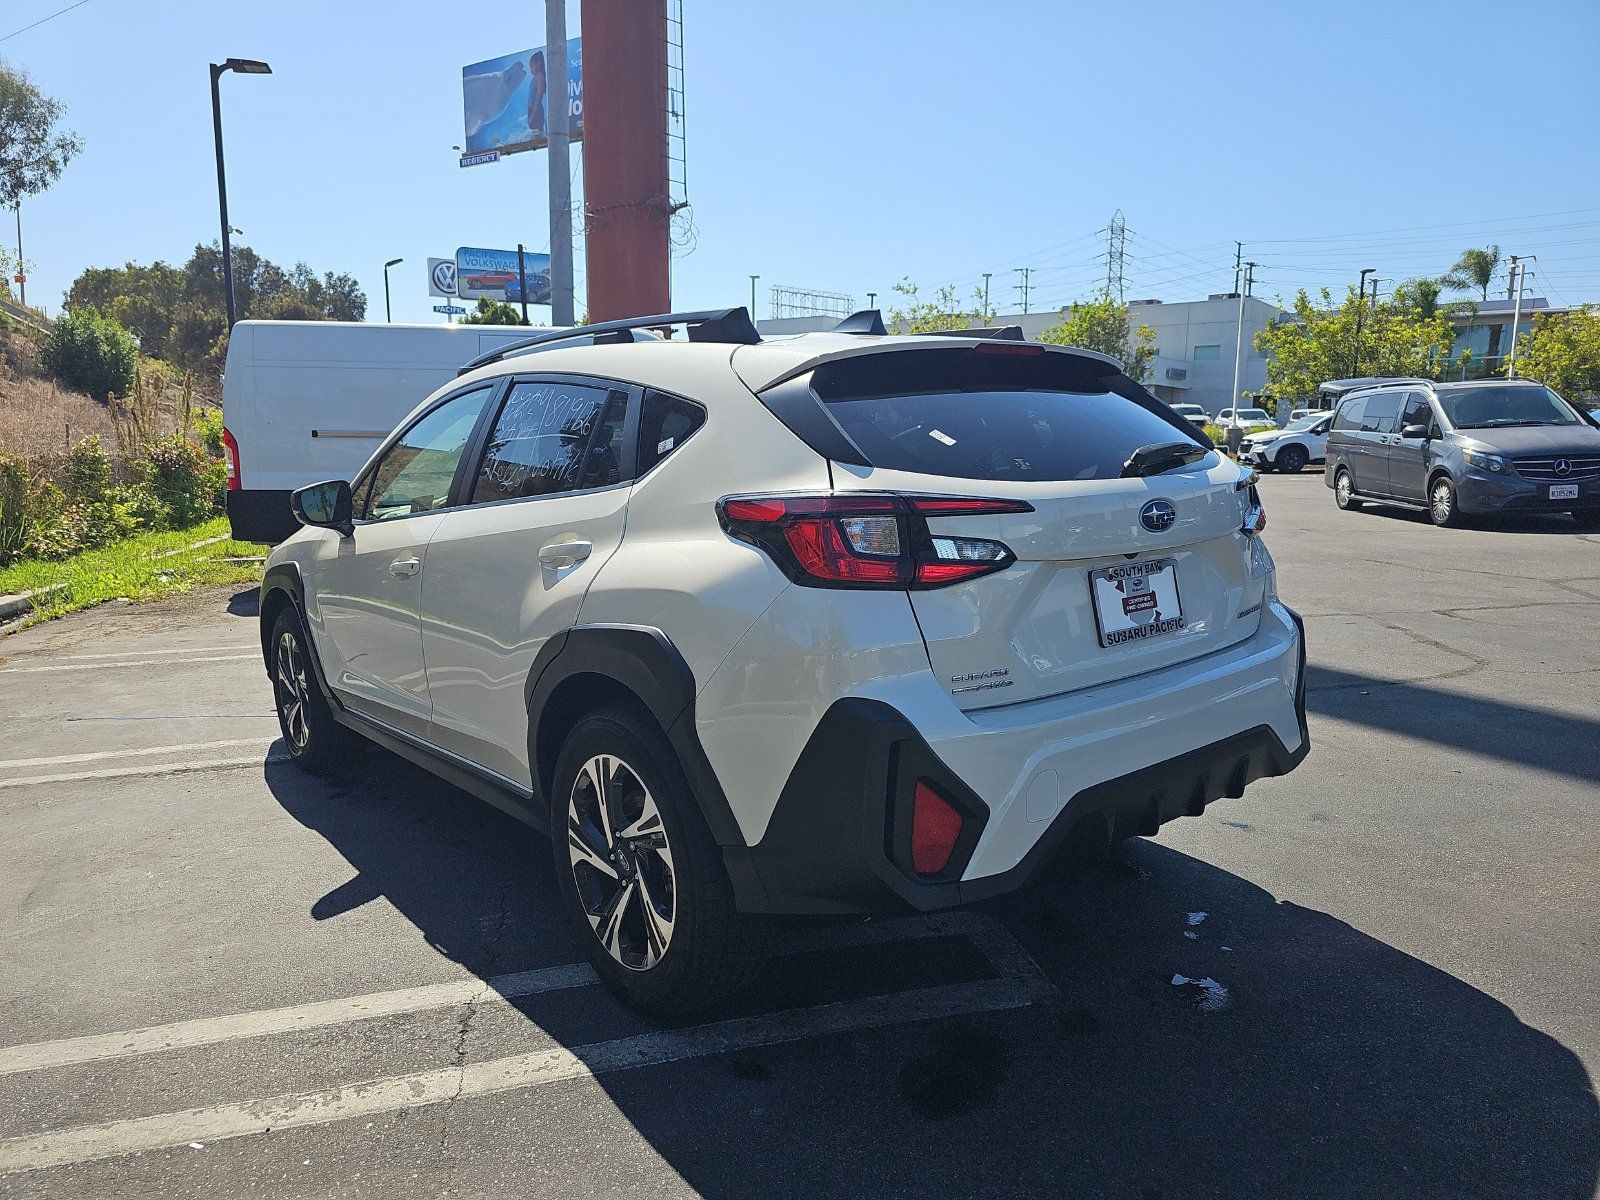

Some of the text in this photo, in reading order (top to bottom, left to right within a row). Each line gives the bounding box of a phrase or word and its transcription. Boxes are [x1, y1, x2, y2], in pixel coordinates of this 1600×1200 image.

[462, 153, 496, 166] REGENCY
[464, 249, 498, 260] PACIFIC
[435, 306, 466, 314] PACIFIC
[1113, 562, 1160, 579] SOUTH BAY
[1107, 618, 1184, 645] SUBARU PACIFIC
